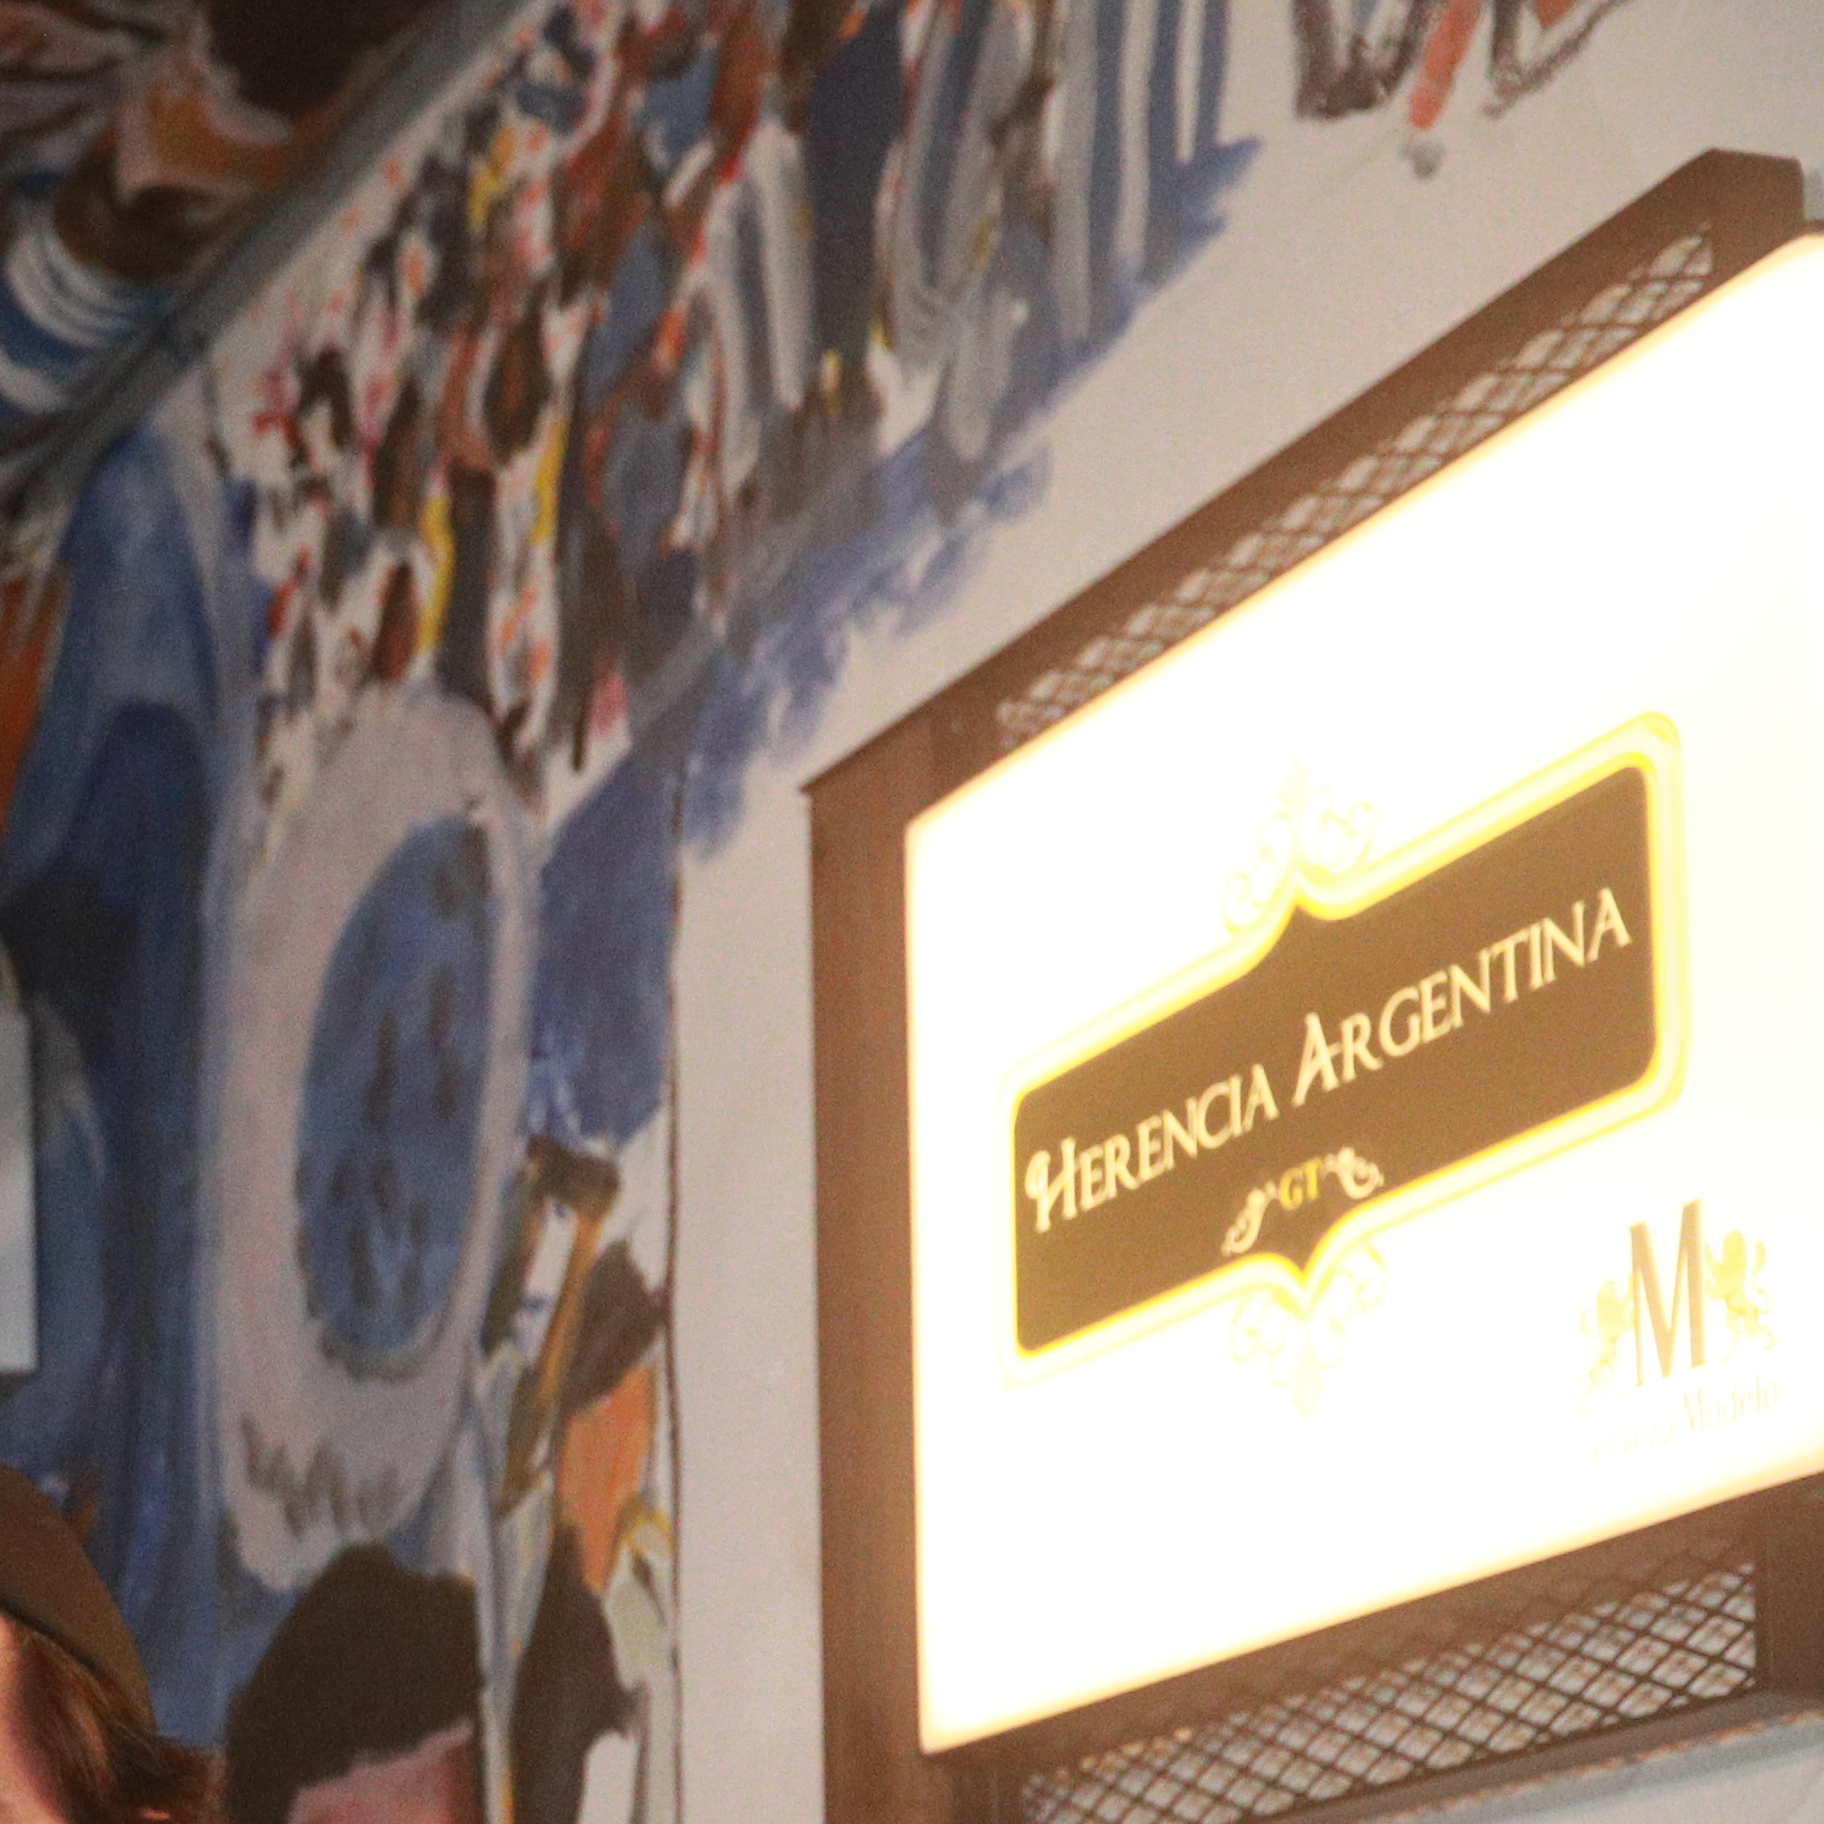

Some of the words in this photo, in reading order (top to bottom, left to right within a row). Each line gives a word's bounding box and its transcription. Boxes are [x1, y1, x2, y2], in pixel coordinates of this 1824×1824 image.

[1024, 1062, 1280, 1233] HERENCIA
[1291, 886, 1632, 1107] ARGENTINA
[1279, 1156, 1323, 1212] GT
